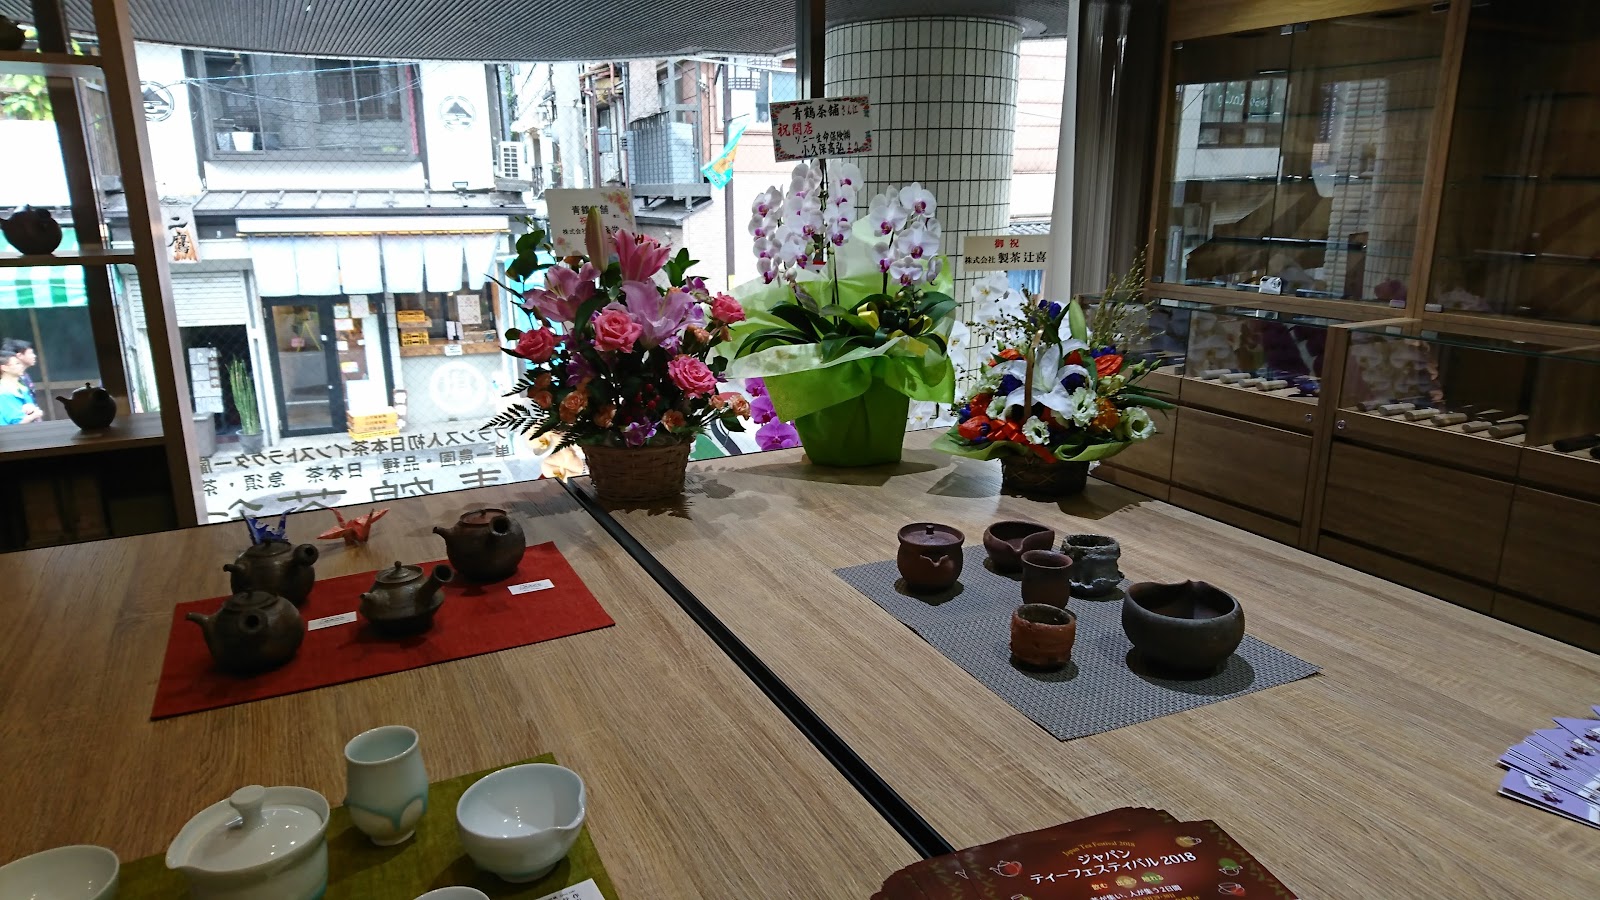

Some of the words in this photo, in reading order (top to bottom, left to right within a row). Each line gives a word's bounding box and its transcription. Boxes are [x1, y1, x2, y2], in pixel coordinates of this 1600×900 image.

[777, 121, 813, 137] 祝開店
[571, 204, 609, 216] 青鶴舗
[1077, 849, 1131, 865] ジャパン
[1030, 857, 1160, 885] ティーフェスティバル
[1160, 851, 1197, 866] 2018
